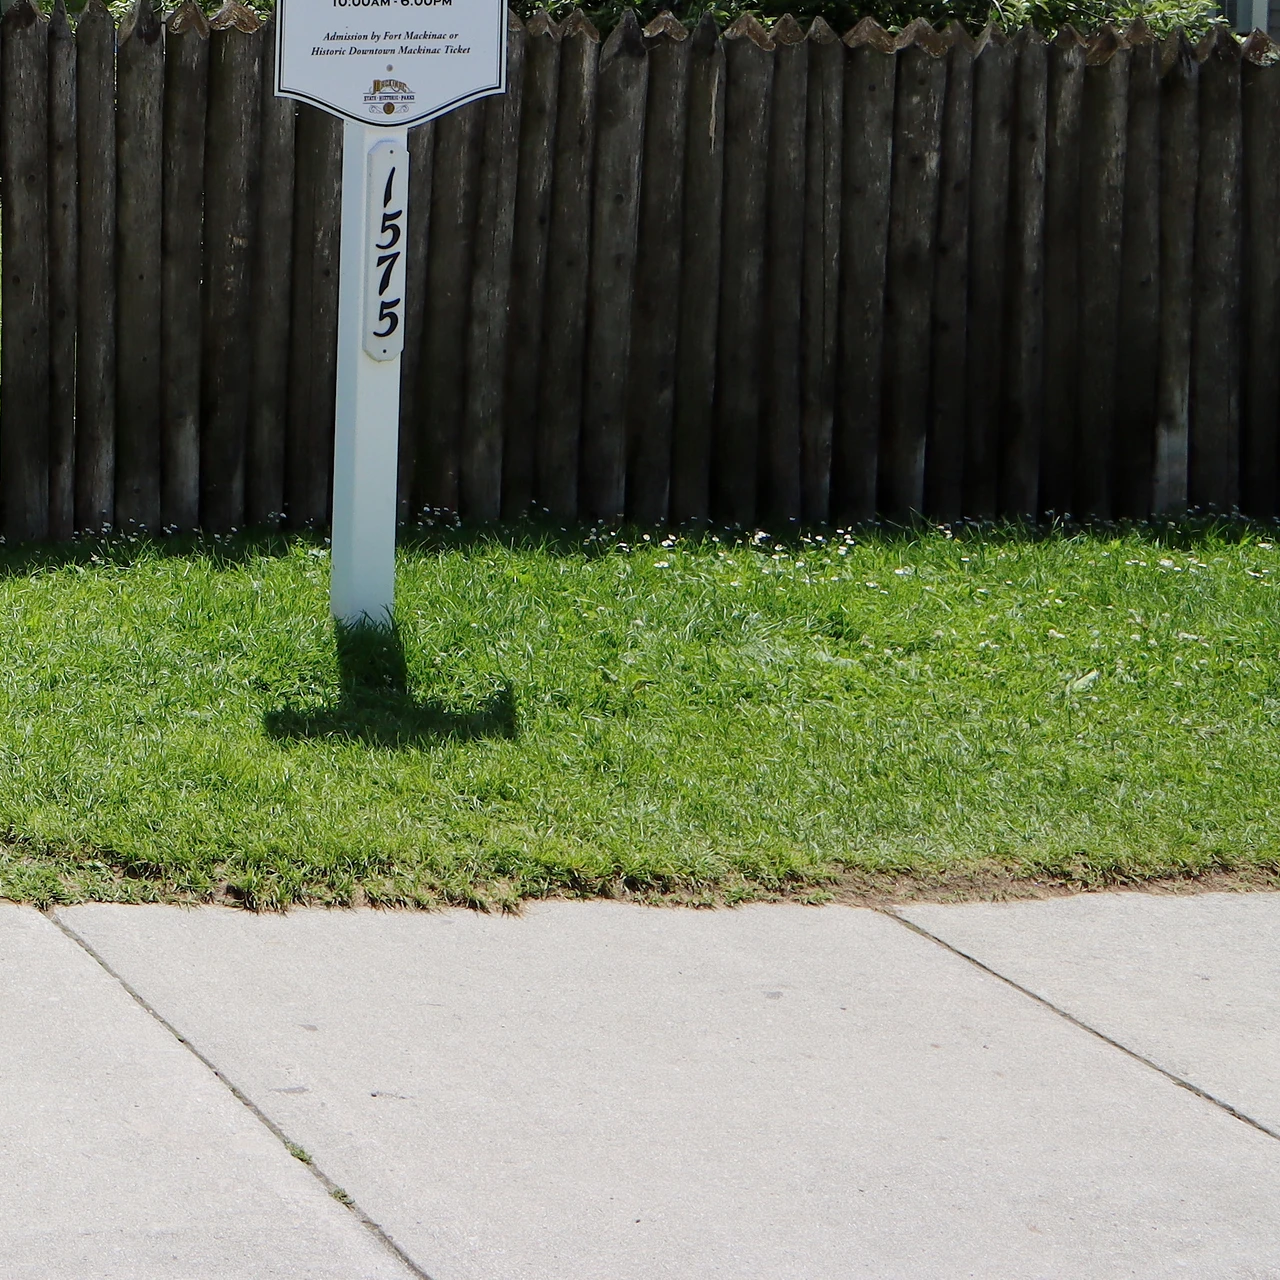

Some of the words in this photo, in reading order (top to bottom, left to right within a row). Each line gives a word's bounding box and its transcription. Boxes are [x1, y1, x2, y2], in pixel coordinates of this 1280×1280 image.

[322, 30, 368, 42] Admission
[370, 30, 381, 44] by
[382, 30, 403, 41] Fort
[403, 30, 447, 41] Mackinac
[310, 46, 347, 57] Historic
[348, 46, 396, 56] Downtown
[397, 45, 442, 55] Mackinac
[444, 44, 471, 55] Ticket
[372, 166, 403, 338] 1575
